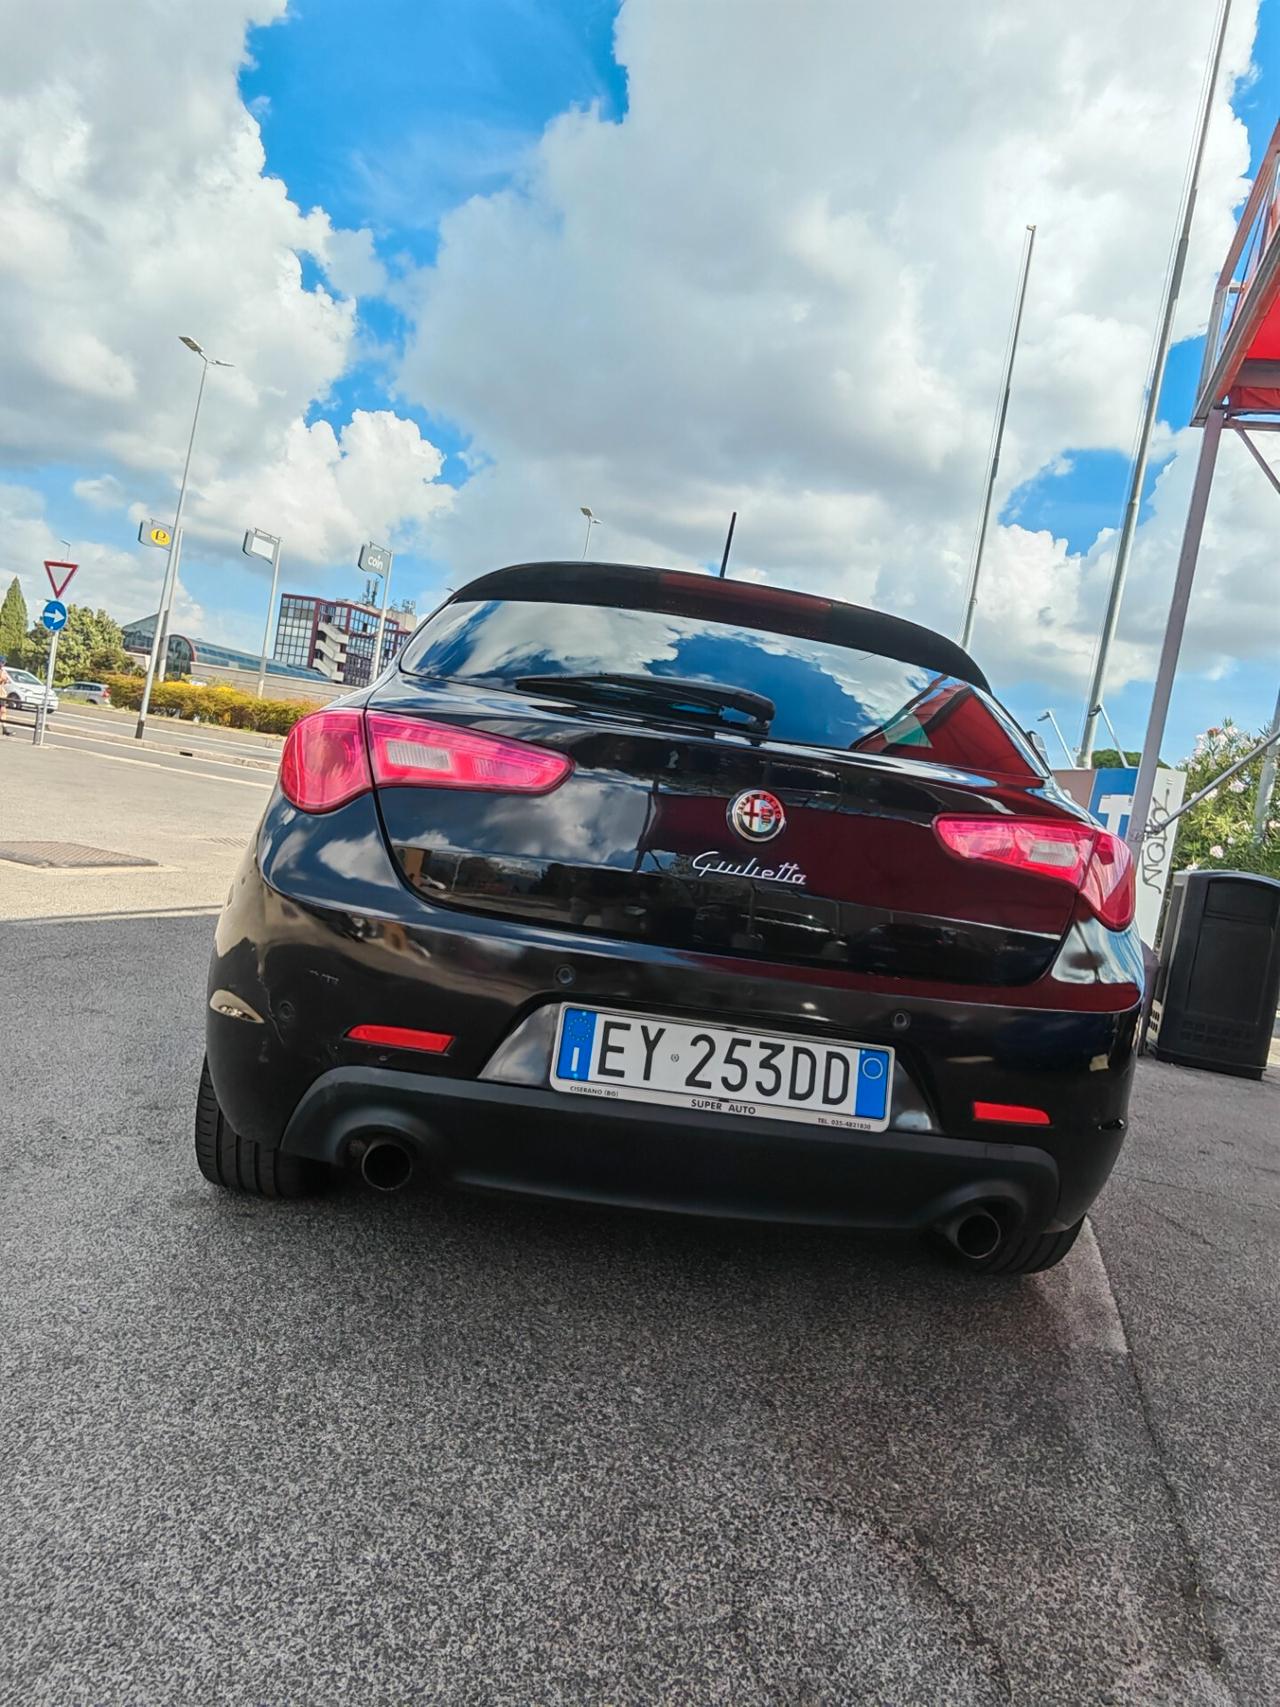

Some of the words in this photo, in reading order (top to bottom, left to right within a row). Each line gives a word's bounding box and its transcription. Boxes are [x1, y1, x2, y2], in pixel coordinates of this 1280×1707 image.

[368, 555, 384, 571] coin
[692, 851, 807, 885] Giulietta
[597, 1021, 666, 1081] EY
[684, 1034, 850, 1106] 253DD
[570, 1086, 603, 1096] CISERANO
[691, 1099, 722, 1110] SUPER
[728, 1104, 756, 1114] AUTO
